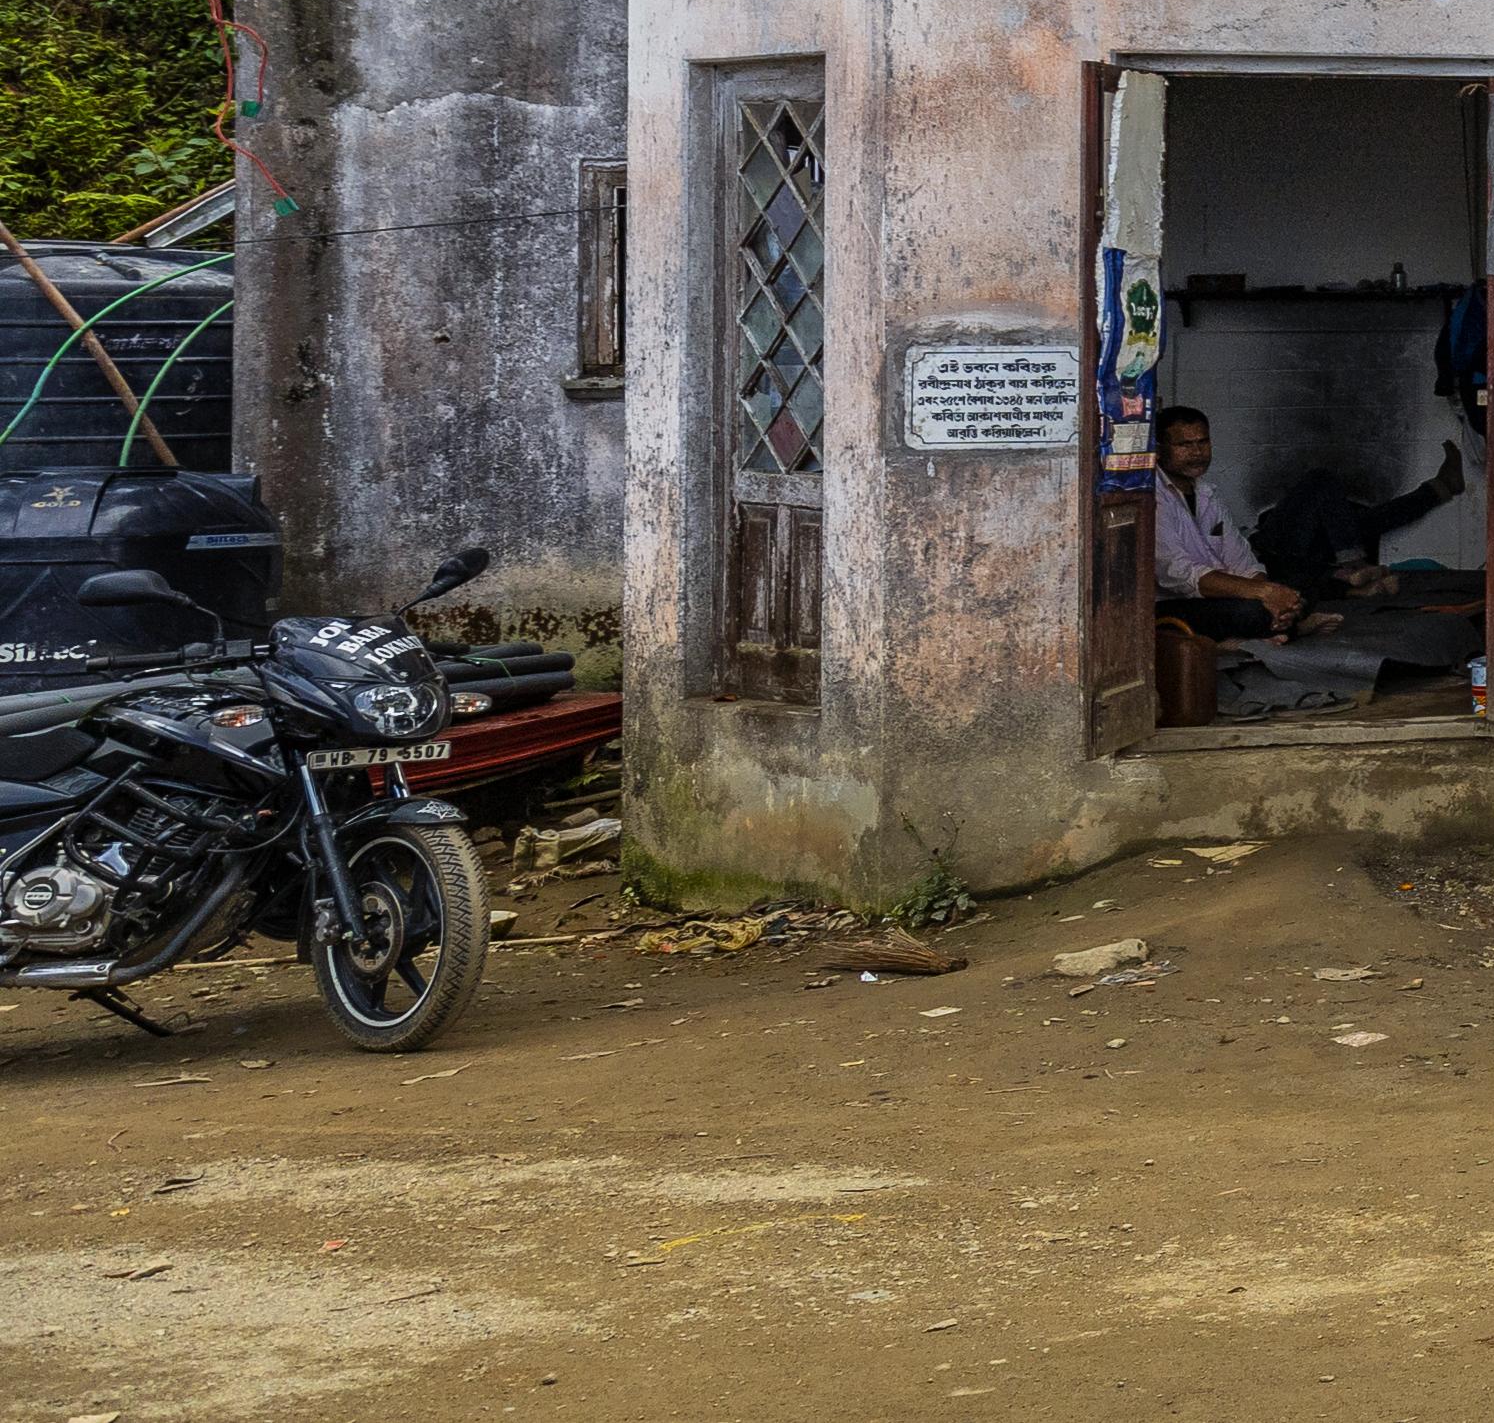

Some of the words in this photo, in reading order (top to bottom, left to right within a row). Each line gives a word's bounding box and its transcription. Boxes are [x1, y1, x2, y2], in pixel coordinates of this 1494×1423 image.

[938, 360, 959, 373] এই
[963, 363, 999, 373] ভবনে
[1002, 358, 1056, 373] কবিগুরু
[918, 375, 972, 390] রবীন্দ্রনাথ
[974, 376, 1005, 393] ঠাকুর
[1008, 379, 1028, 389] বাস
[1030, 375, 1076, 389] করিতেন
[918, 396, 939, 405] এবং
[939, 396, 966, 405] ২৫শে
[967, 393, 994, 405] বৈশাখ
[931, 409, 965, 422] কবিতা
[967, 407, 1031, 421] আকাশবাণীর
[1033, 411, 1063, 421] মাধ্যমে
[947, 425, 978, 440] আবৃত্তি
[309, 621, 352, 647] JOI
[336, 625, 392, 654] BABA
[330, 753, 352, 766] WB
[367, 749, 388, 763] 79
[402, 744, 446, 759] 5507
